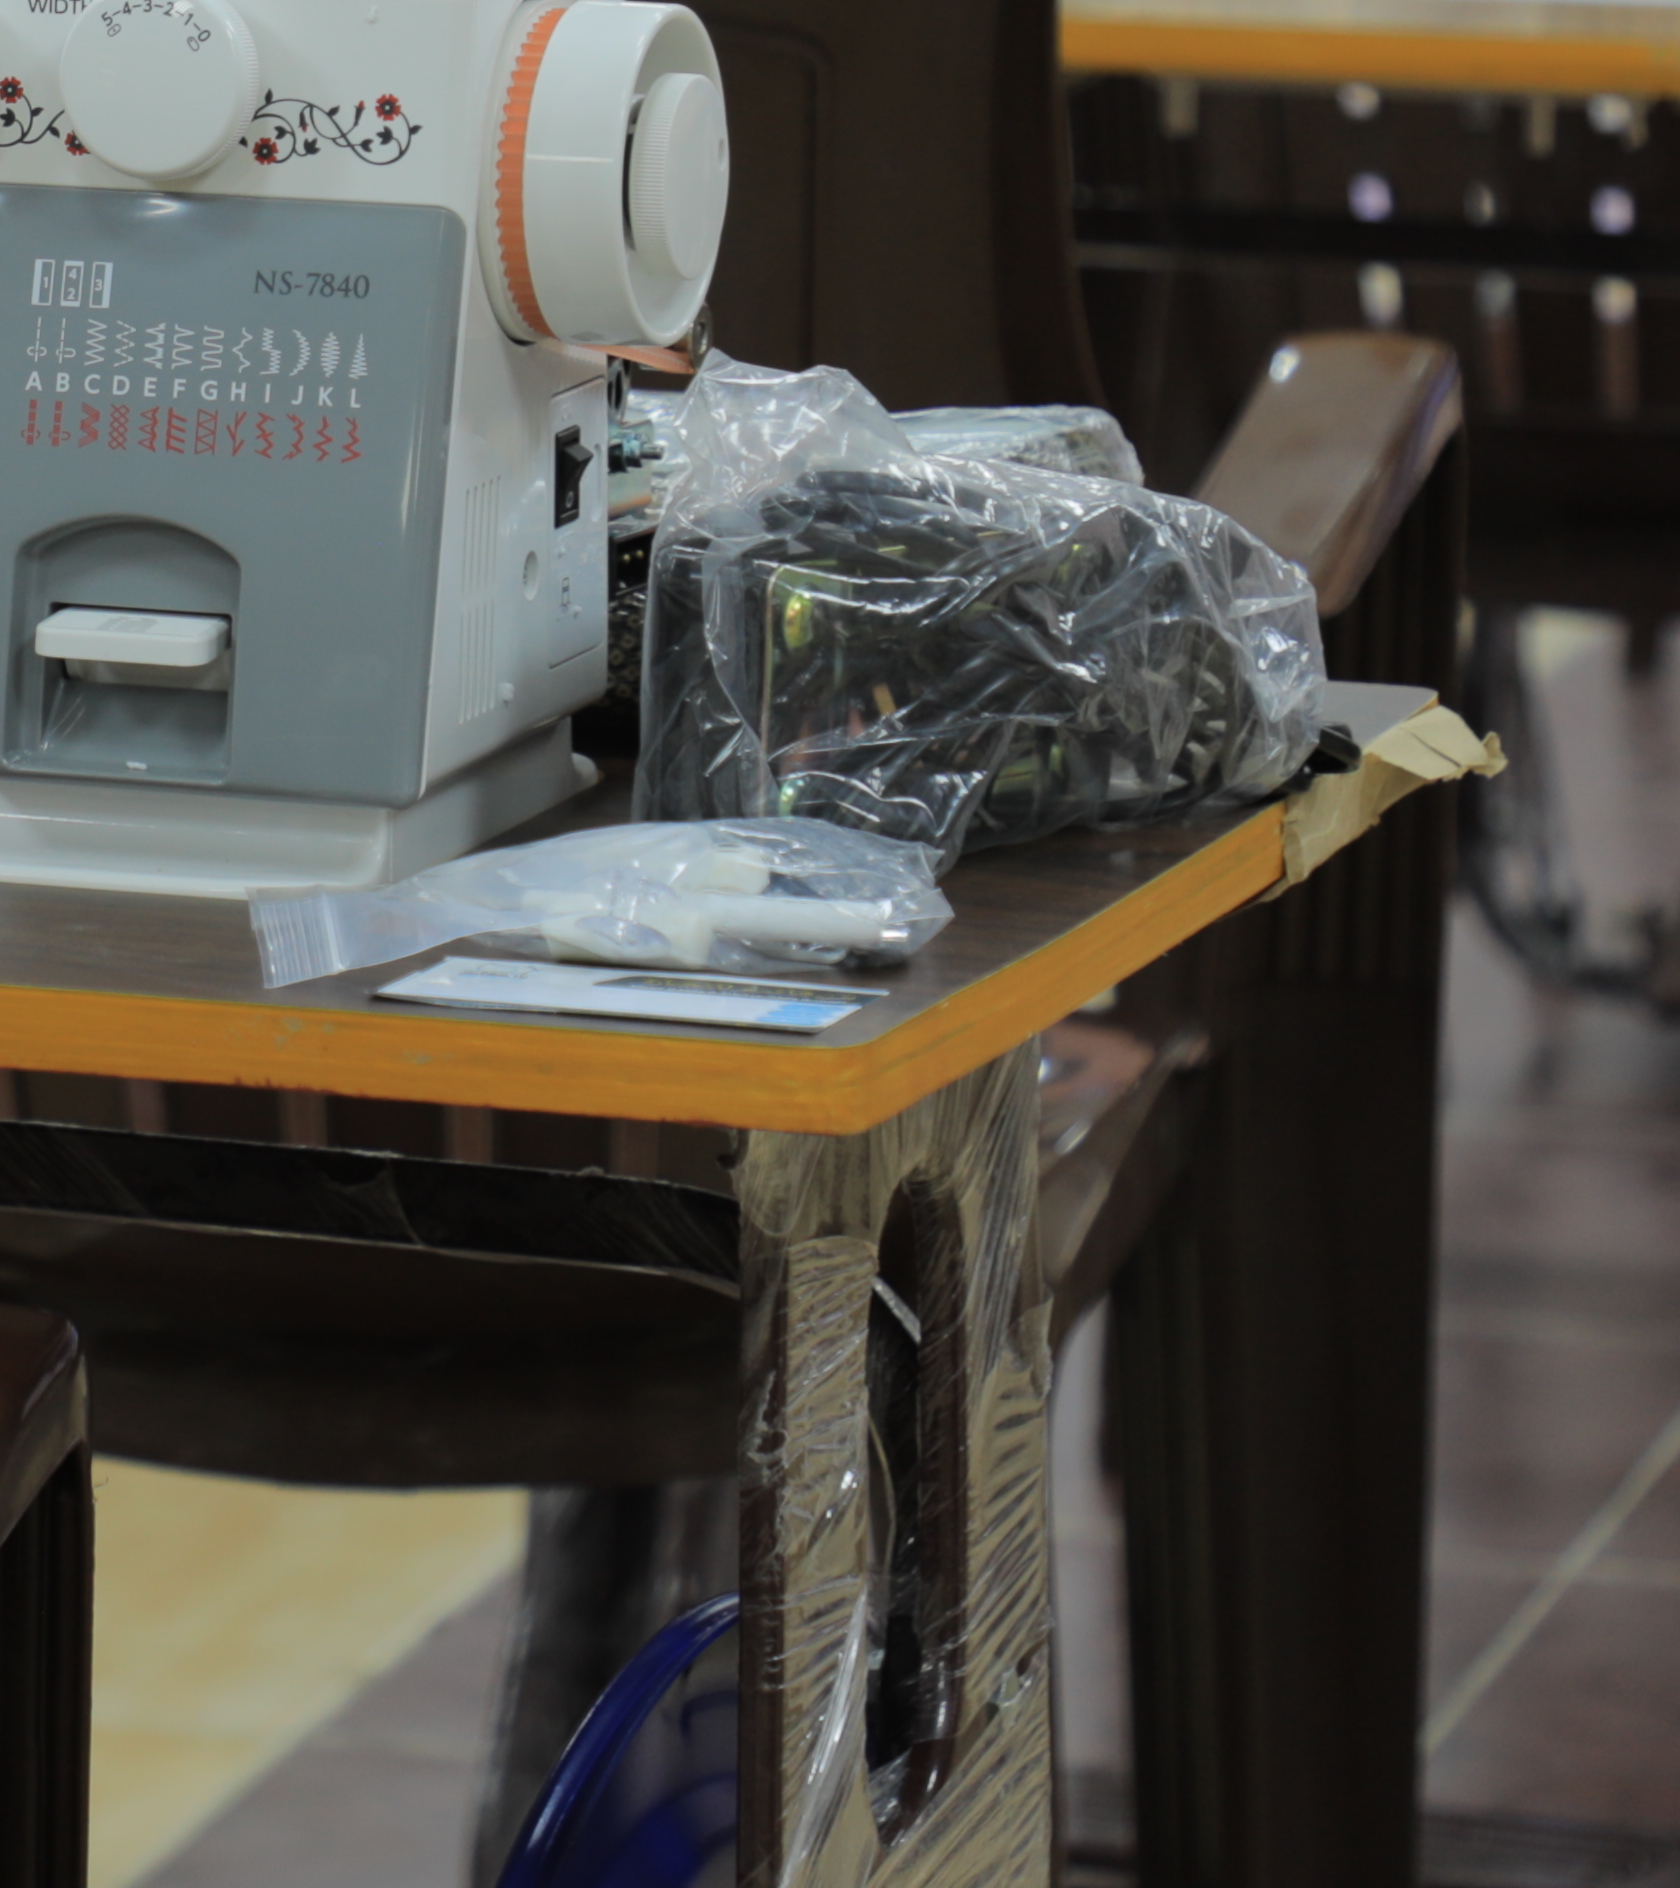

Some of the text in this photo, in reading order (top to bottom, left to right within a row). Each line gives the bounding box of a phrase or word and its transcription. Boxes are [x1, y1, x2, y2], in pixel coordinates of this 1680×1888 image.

[101, 11, 113, 27] 5
[122, 1, 132, 15] 4
[163, 1, 174, 17] 2
[184, 13, 194, 26] 1
[197, 29, 211, 42] 0
[68, 267, 77, 280] 4
[43, 276, 49, 289] 1
[94, 278, 103, 291] 3
[253, 270, 370, 299] NS-7840
[67, 287, 76, 300] 2
[24, 371, 361, 408] A B C D E F G H I J K L
